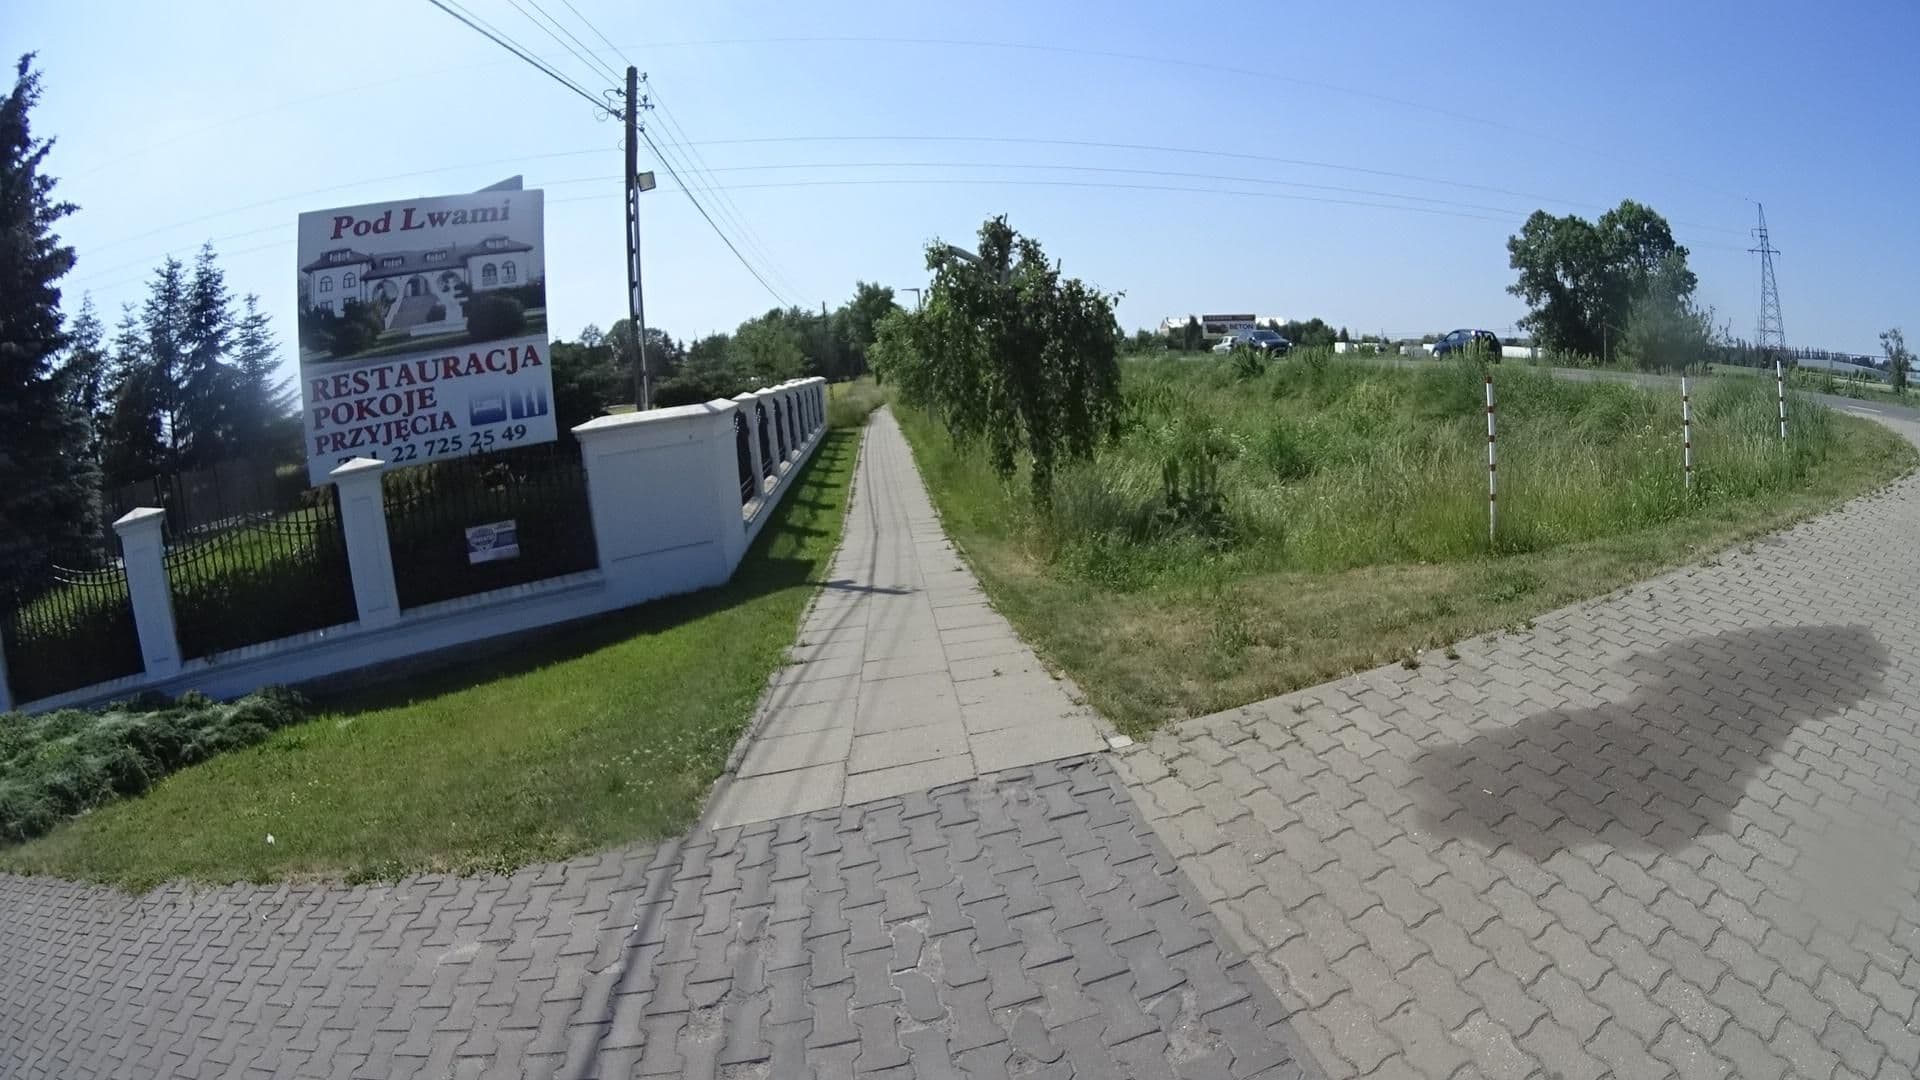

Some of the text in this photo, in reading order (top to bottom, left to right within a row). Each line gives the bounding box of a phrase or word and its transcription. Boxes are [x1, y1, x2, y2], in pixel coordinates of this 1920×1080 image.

[330, 200, 511, 240] Pod Lwami
[310, 345, 543, 402] RESTAURACJA
[312, 387, 438, 430] POKOJE
[315, 411, 457, 455] PRZYJĘCIA
[391, 444, 417, 462] 22
[424, 435, 463, 456] 725
[469, 430, 495, 448] 25
[502, 424, 527, 441] 49
